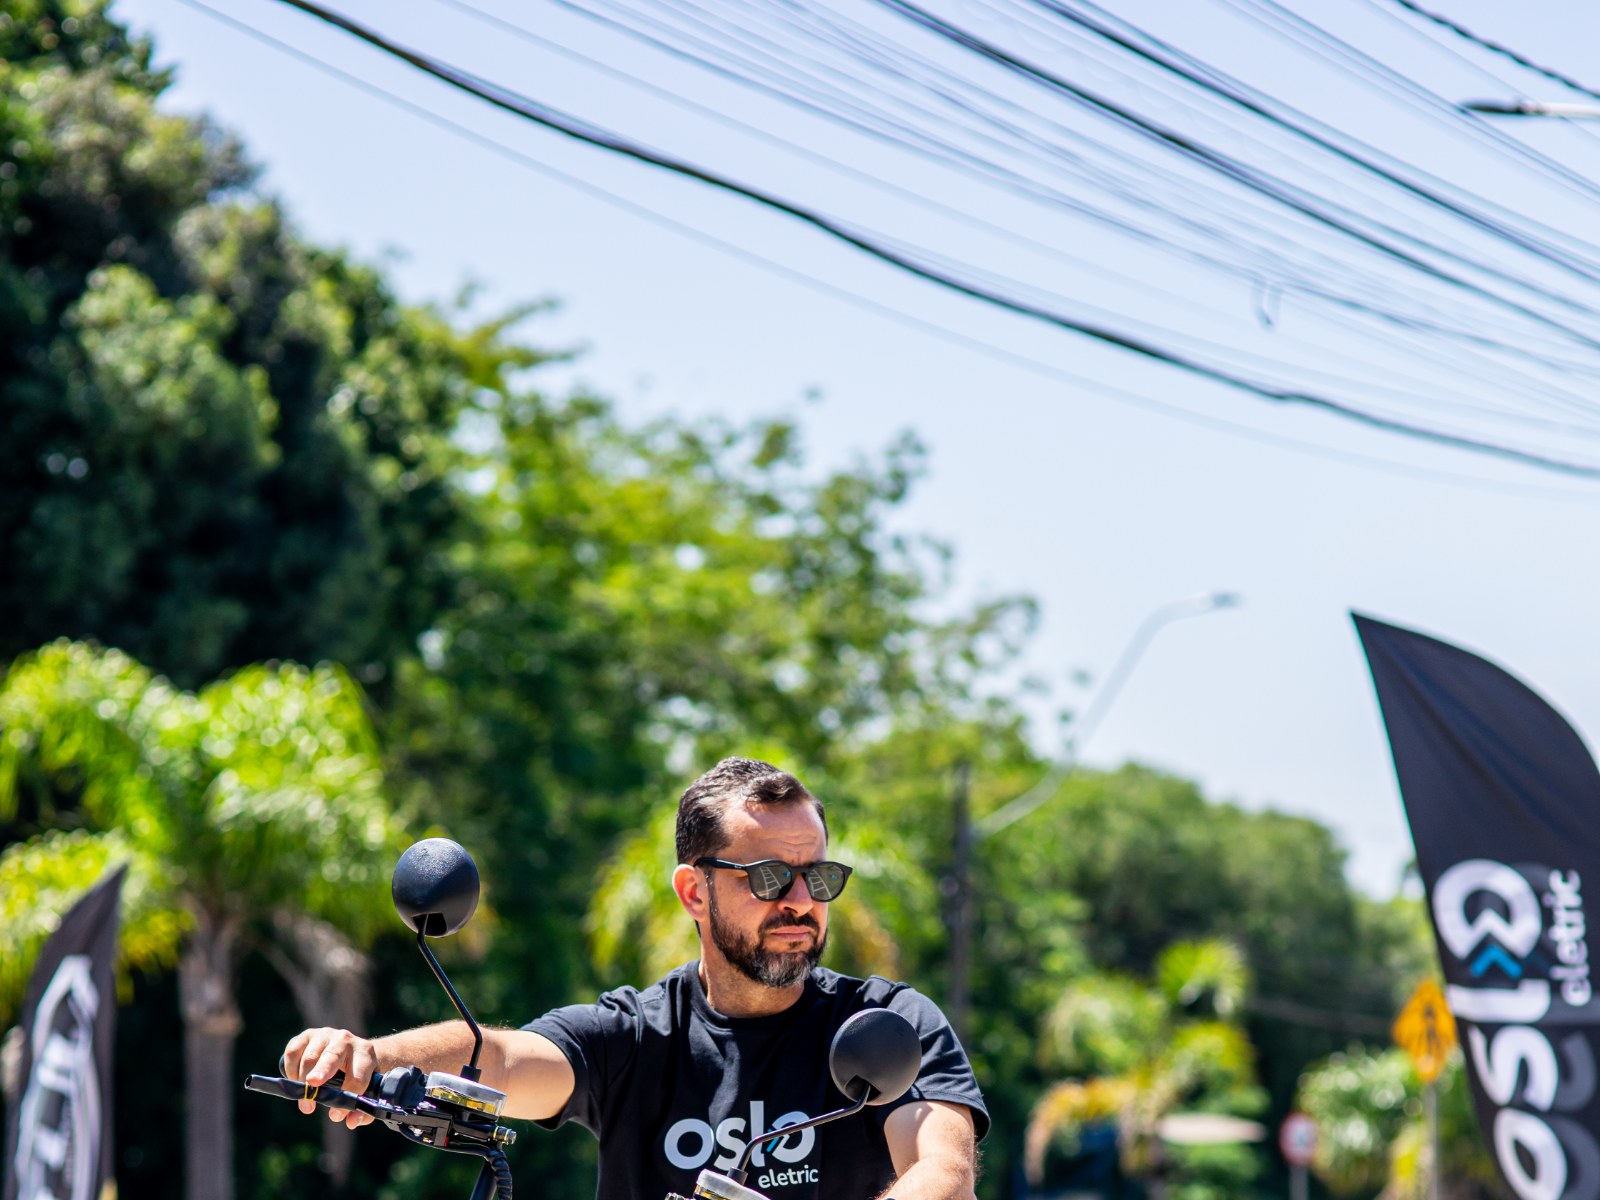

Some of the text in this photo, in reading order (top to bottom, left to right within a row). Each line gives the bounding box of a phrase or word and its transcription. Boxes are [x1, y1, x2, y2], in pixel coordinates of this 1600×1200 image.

[1546, 868, 1592, 1006] eletric
[664, 1100, 815, 1170] oslo
[758, 1165, 819, 1189] eletric
